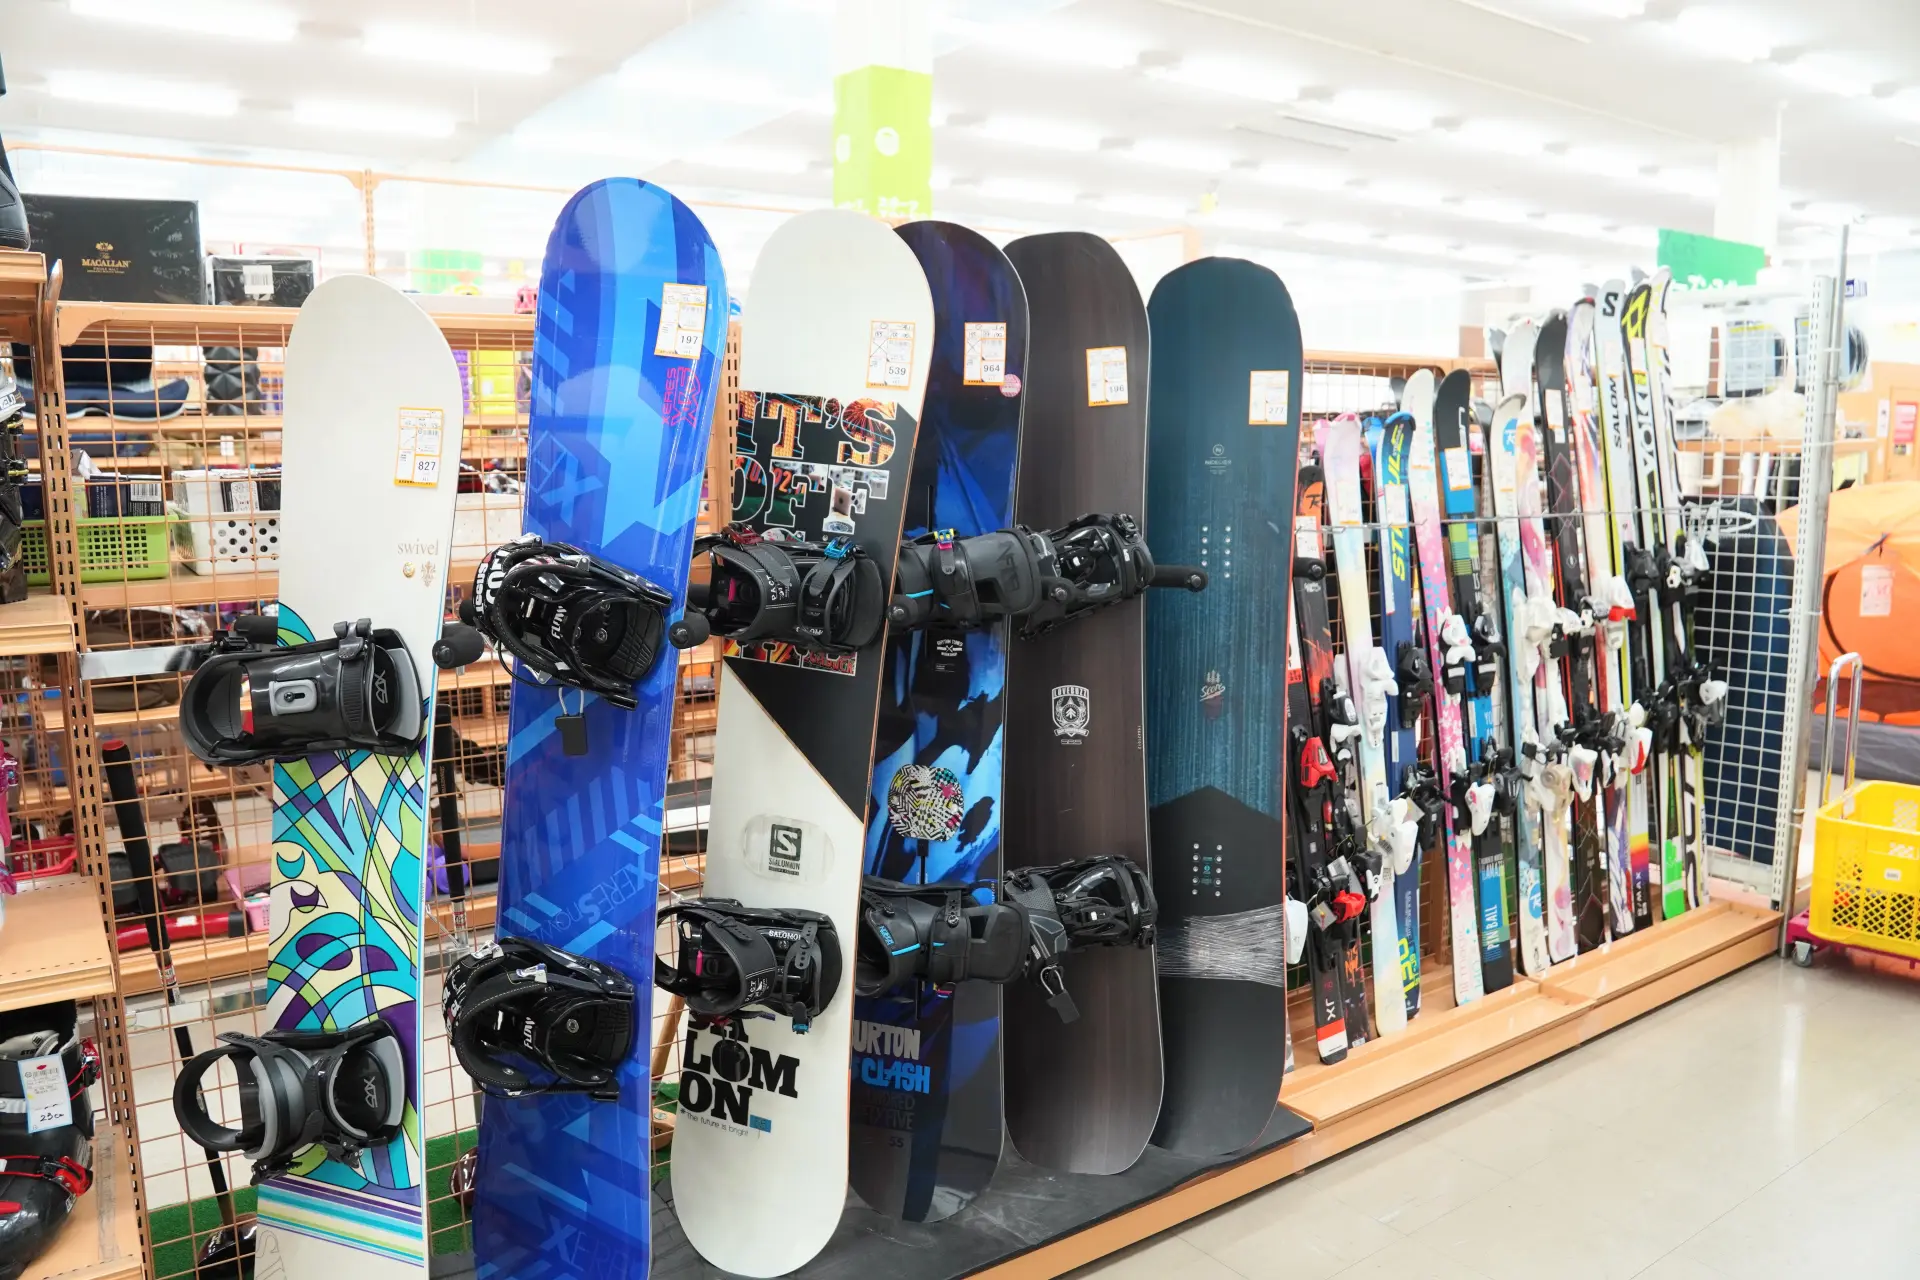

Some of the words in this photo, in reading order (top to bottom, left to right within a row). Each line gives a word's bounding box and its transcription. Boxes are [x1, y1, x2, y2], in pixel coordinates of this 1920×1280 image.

[81, 259, 131, 268] MACALLAN
[680, 335, 699, 345] 197
[888, 366, 907, 376] 539
[983, 364, 1000, 373] 964
[1268, 406, 1284, 414] 277
[418, 461, 436, 471] 827
[397, 538, 439, 555] swivel
[768, 929, 802, 940] SALOMO
[853, 1019, 920, 1060] URTON
[679, 1070, 753, 1127] ON
[700, 1116, 720, 1129] future
[721, 1122, 727, 1131] is
[728, 1125, 749, 1137] bright
